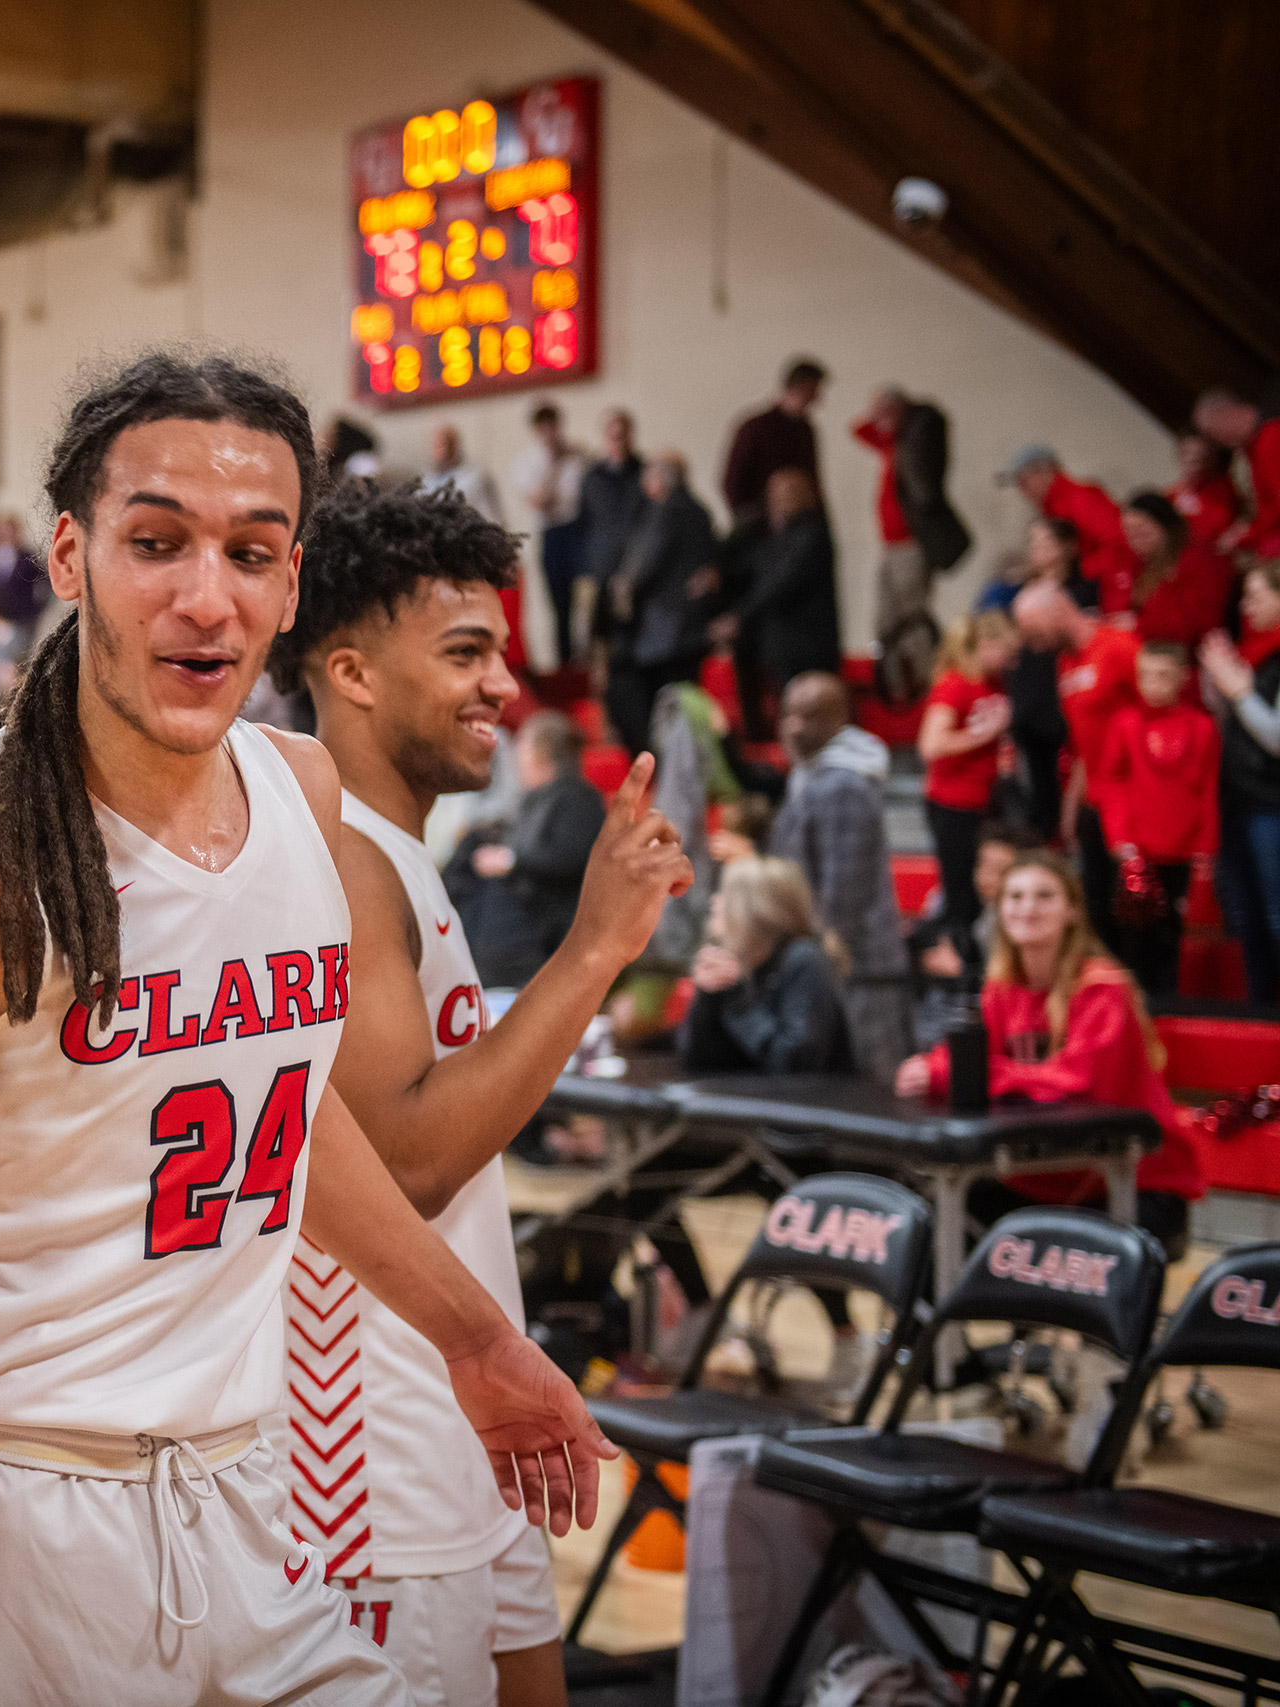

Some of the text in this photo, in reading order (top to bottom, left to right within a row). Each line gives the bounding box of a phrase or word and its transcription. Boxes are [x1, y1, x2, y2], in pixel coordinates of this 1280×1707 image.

[60, 943, 349, 1065] CLARK
[143, 1060, 311, 1260] 24
[768, 1195, 903, 1265] CLARK
[989, 1233, 1118, 1298] CLARK
